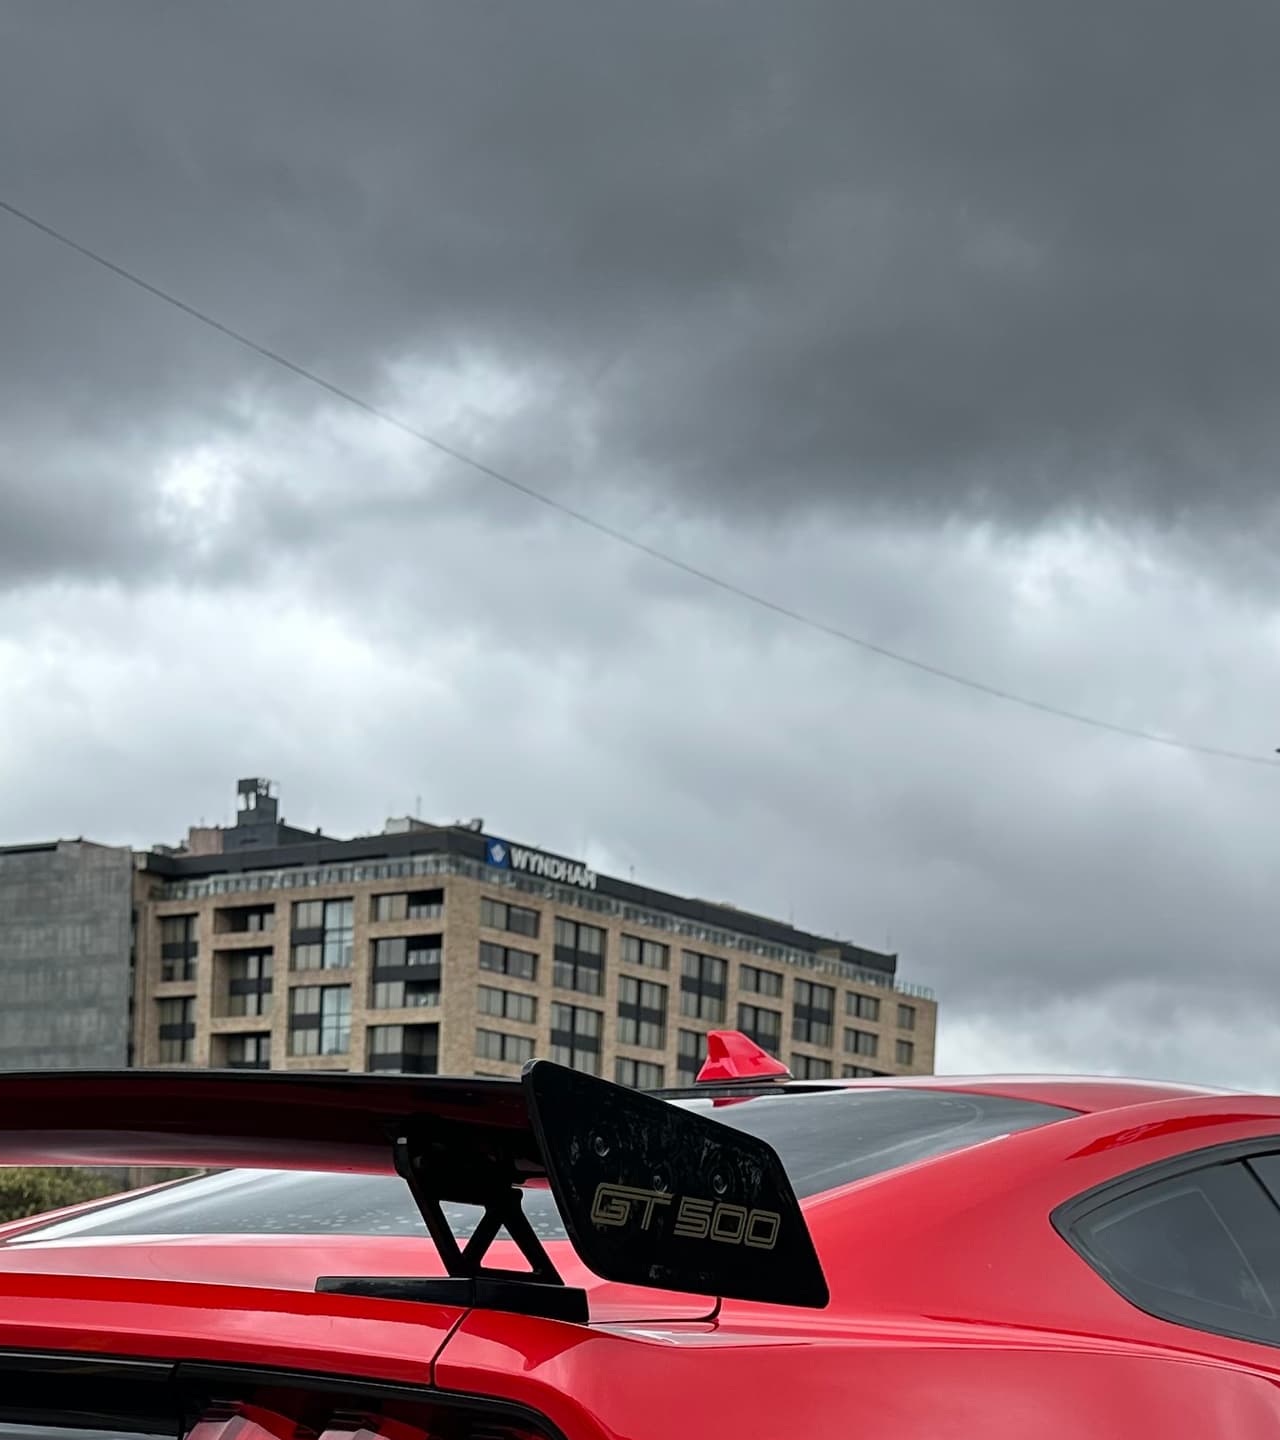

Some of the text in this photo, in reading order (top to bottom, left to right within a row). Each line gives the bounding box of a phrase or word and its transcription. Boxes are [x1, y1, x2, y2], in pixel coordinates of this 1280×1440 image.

[510, 847, 597, 890] WYNDHAM
[590, 1182, 781, 1250] GT 500
